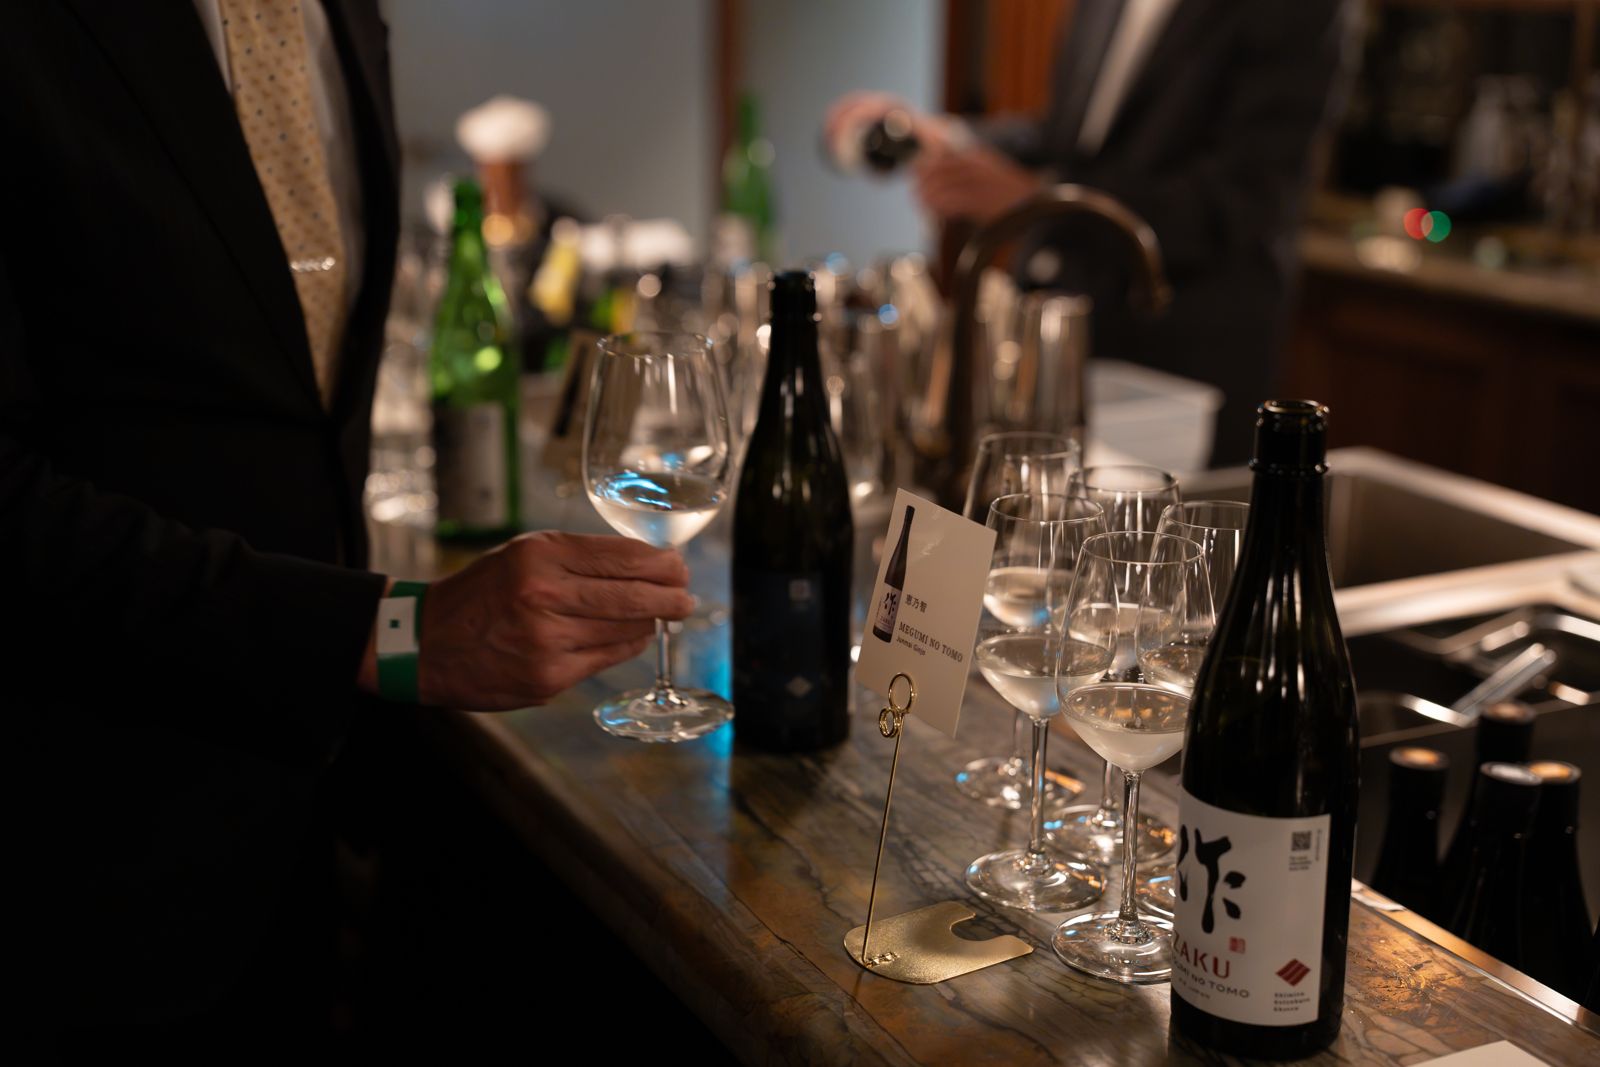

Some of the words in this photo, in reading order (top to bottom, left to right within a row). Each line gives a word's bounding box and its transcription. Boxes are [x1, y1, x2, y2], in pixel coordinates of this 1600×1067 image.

[899, 621, 929, 645] MEGUMI
[929, 638, 940, 651] NO
[942, 644, 963, 662] TOMO
[1173, 930, 1230, 979] ZAKU
[1192, 974, 1206, 985] NO
[1209, 980, 1250, 999] TOMO
